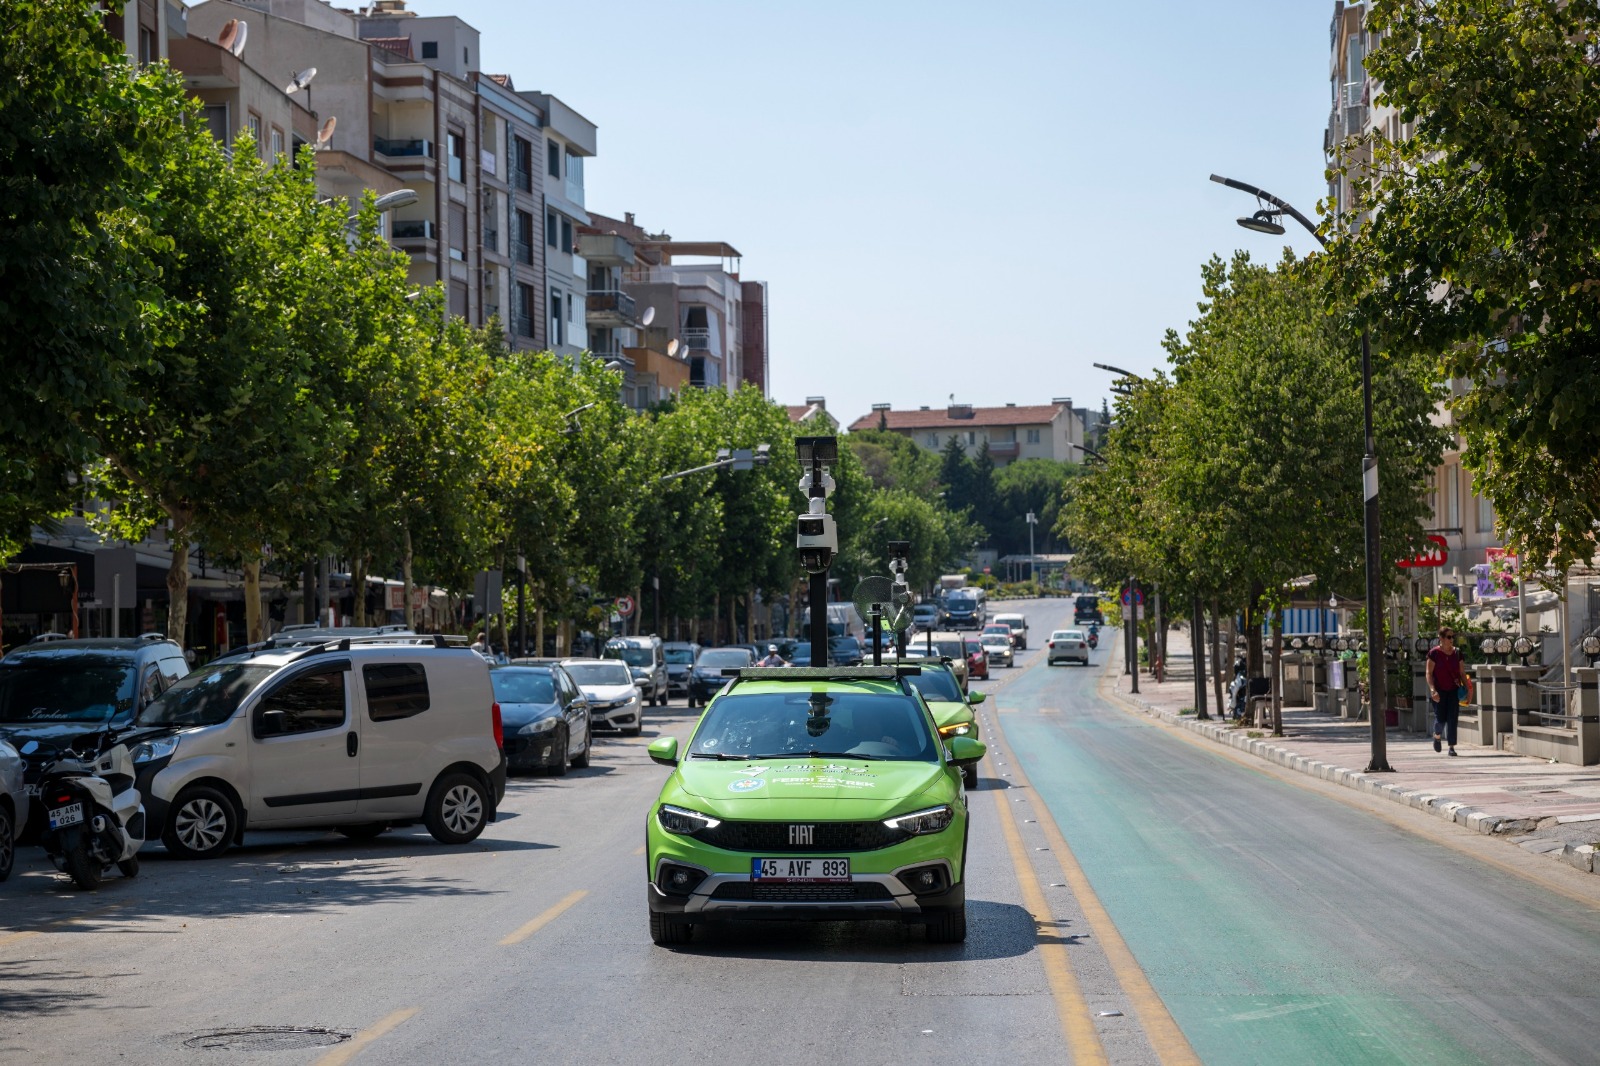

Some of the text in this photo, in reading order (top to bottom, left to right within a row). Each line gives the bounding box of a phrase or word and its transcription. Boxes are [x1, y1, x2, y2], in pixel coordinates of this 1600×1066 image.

[50, 804, 80, 818] 45 ARN
[59, 814, 76, 825] 026
[788, 824, 815, 845] FIAT
[761, 861, 777, 876] 45
[788, 861, 812, 876] AVF
[822, 861, 847, 876] 893
